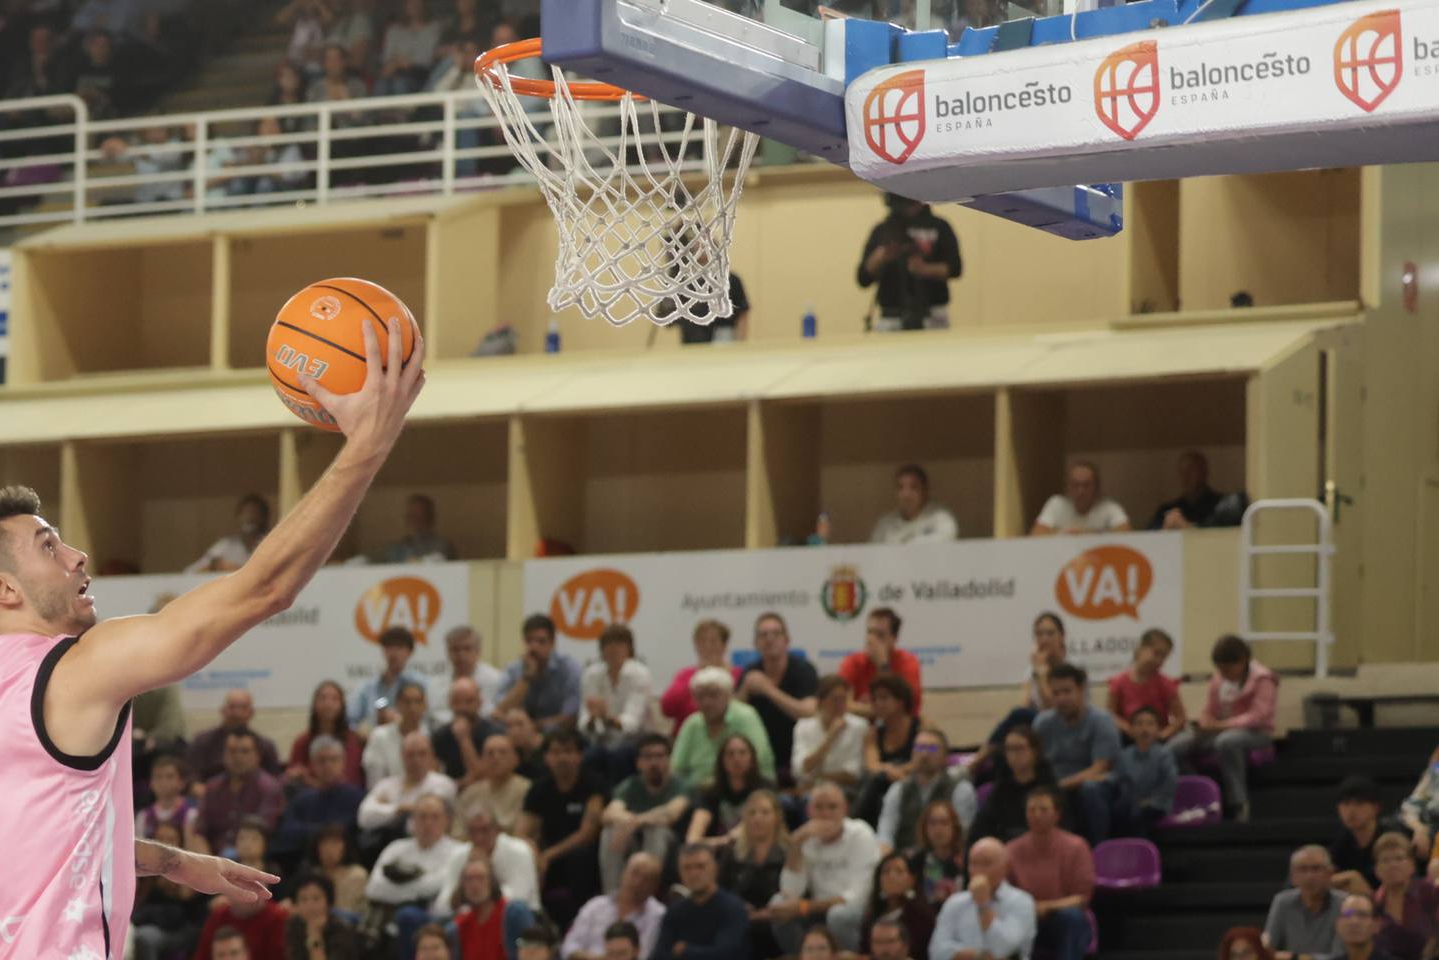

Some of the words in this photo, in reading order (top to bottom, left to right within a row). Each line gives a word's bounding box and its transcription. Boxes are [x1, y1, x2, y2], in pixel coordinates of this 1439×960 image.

[1171, 89, 1230, 106] ESPAÑA
[936, 117, 993, 133] ESPAÑA
[912, 577, 1017, 601] Valladolid
[1065, 564, 1138, 608] VA!
